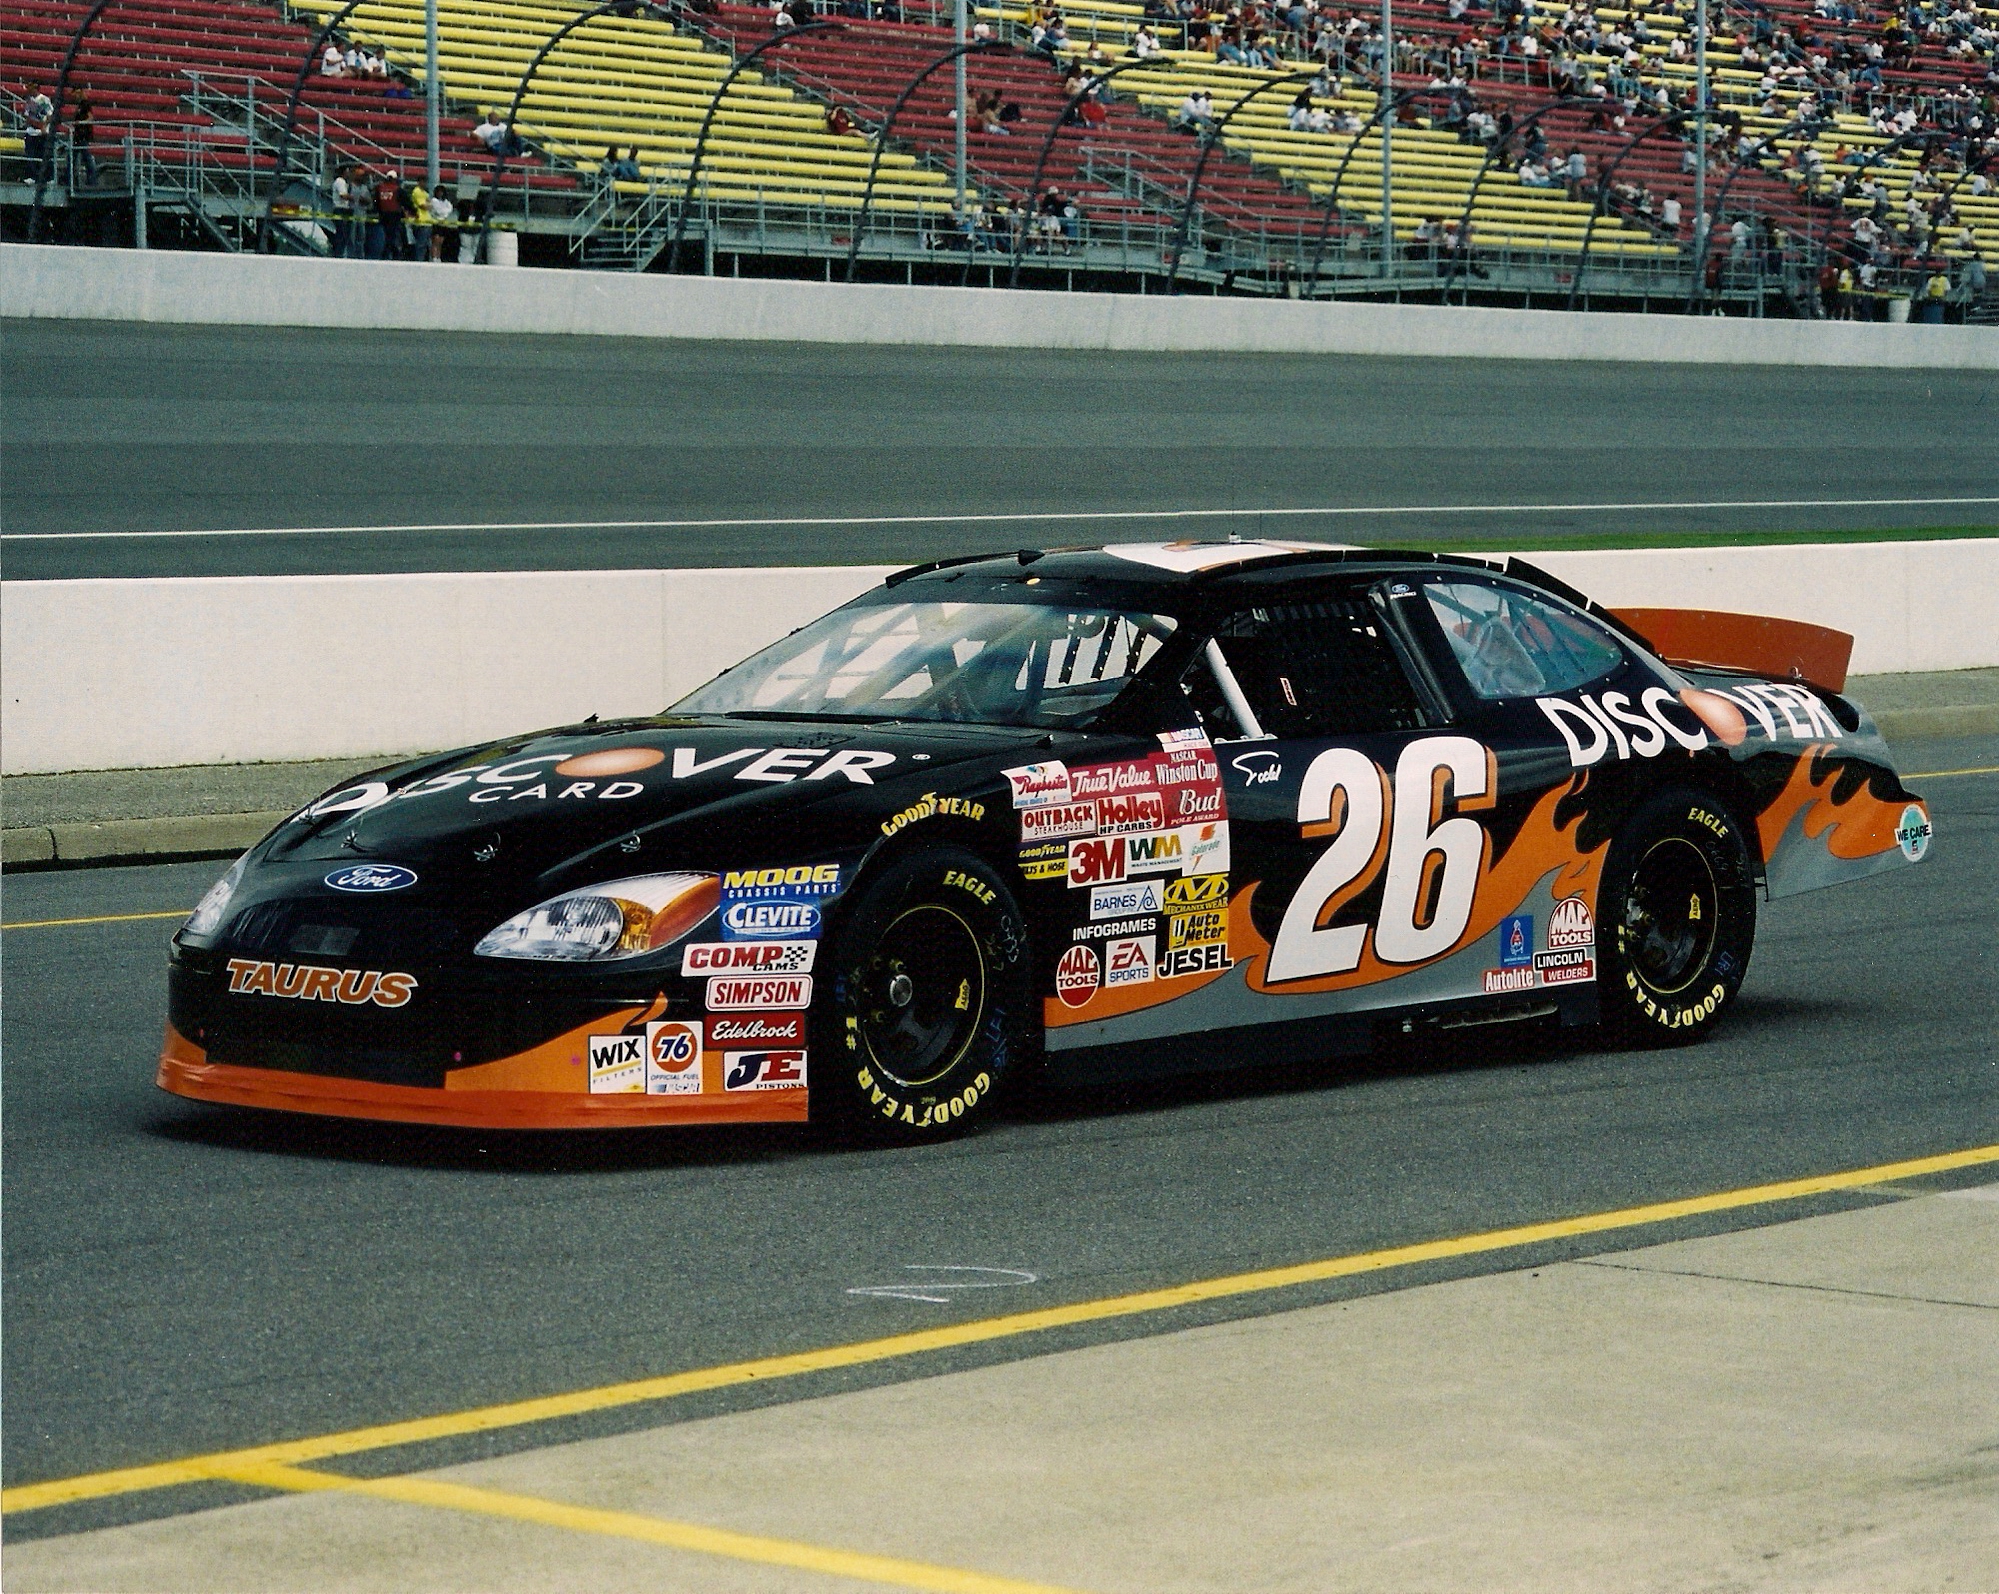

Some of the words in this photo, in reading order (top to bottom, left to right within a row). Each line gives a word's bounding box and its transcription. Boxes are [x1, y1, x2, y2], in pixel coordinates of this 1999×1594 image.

[1535, 684, 1843, 767] DISCOVER
[1170, 750, 1198, 763] NASCAR
[1155, 762, 1198, 785] Winston
[1197, 758, 1219, 782] Cup
[468, 781, 646, 803] CARD
[1179, 787, 1222, 815] Bud
[881, 791, 986, 837] GOODYEAR
[1024, 804, 1093, 829] OUTBACK
[1098, 796, 1163, 829] Holley
[1193, 813, 1220, 822] AWARD
[1688, 807, 1729, 838] EAGLE
[1034, 821, 1083, 836] STEAKHOUSE
[1100, 825, 1115, 835] HP
[1117, 820, 1153, 833] CARBS
[1897, 828, 1909, 842] WE
[1909, 824, 1931, 840] CARE
[1019, 844, 1067, 859] GOODYEAR
[1129, 834, 1183, 861] WM
[1266, 734, 1491, 985] 26
[1070, 837, 1126, 884] 3M
[337, 866, 403, 888] Ford
[722, 864, 840, 890] MOOG
[943, 870, 997, 905] EAGLE
[728, 886, 786, 899] CHASSIS
[795, 883, 837, 896] PARTS
[1094, 894, 1137, 911] BARNES
[728, 902, 812, 929] CLEVITE
[1164, 902, 1206, 915] MECHANIX
[1205, 896, 1229, 910] WEAR
[1551, 901, 1593, 934] MAC
[1073, 917, 1157, 942] INFOGRAMES
[1188, 913, 1221, 929] Auto
[1184, 926, 1226, 942] Meter
[1551, 931, 1592, 946] TOOLS
[689, 945, 784, 969] COMP
[752, 962, 799, 972] CAMS
[1058, 947, 1099, 977] MAC
[1111, 942, 1149, 971] EA
[1157, 942, 1234, 978] JESEL
[1537, 951, 1583, 968] LINCOLN
[226, 958, 419, 1008] TAURUS
[1058, 974, 1098, 988] TOOLS
[1109, 967, 1149, 983] SPORTS
[1485, 968, 1535, 992] Autolite
[1548, 966, 1589, 981] WELDERS
[714, 981, 803, 1004] SIMPSON
[1626, 970, 1725, 1029] GOODYEAR
[711, 1019, 798, 1041] Edelbrock
[592, 1037, 642, 1070] WIX
[655, 1032, 694, 1063] 76
[650, 1073, 681, 1082] OFFICIAL
[682, 1072, 700, 1081] FUEL
[726, 1051, 804, 1090] JE
[858, 1066, 991, 1127] GOODYEAR
